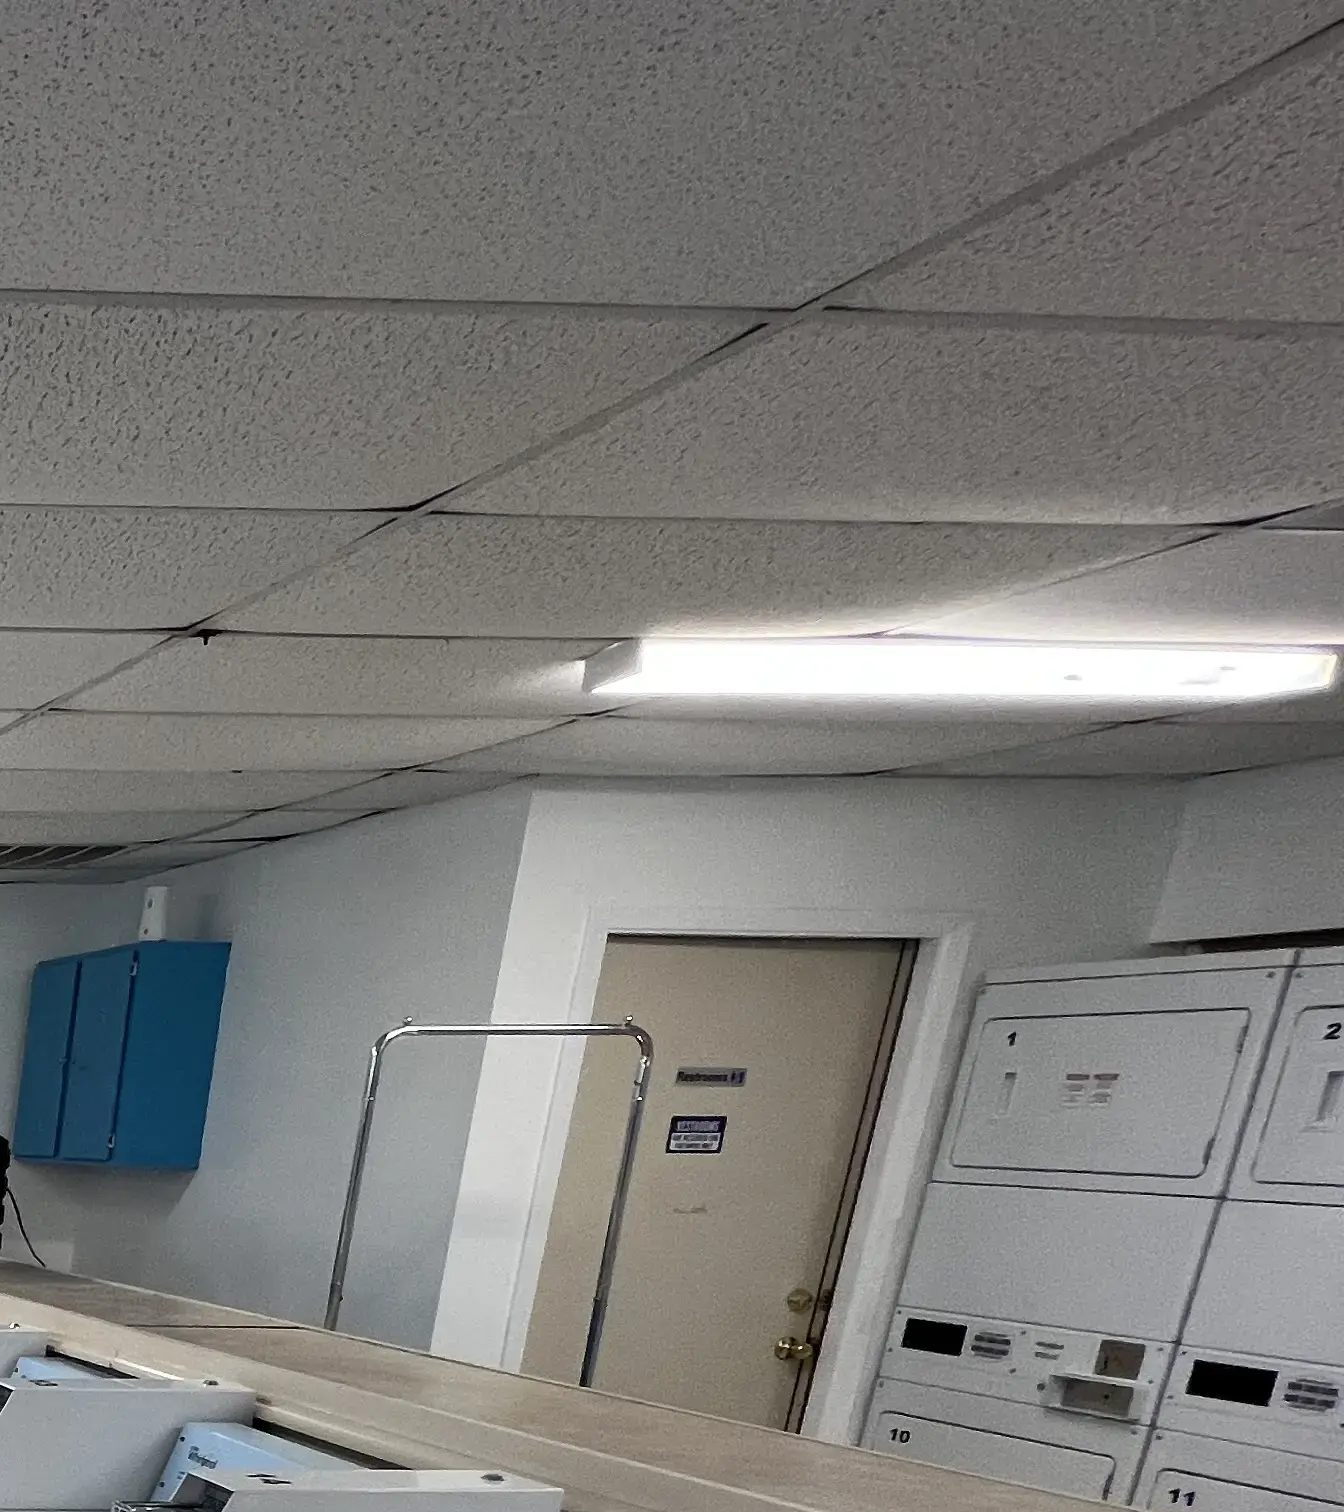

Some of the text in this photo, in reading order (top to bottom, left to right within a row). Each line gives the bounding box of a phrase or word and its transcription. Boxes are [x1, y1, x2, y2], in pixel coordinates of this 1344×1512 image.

[1007, 1031, 1017, 1046] 1
[1322, 1022, 1342, 1040] 2
[890, 1428, 911, 1444] 10
[1169, 1488, 1196, 1507] 11
